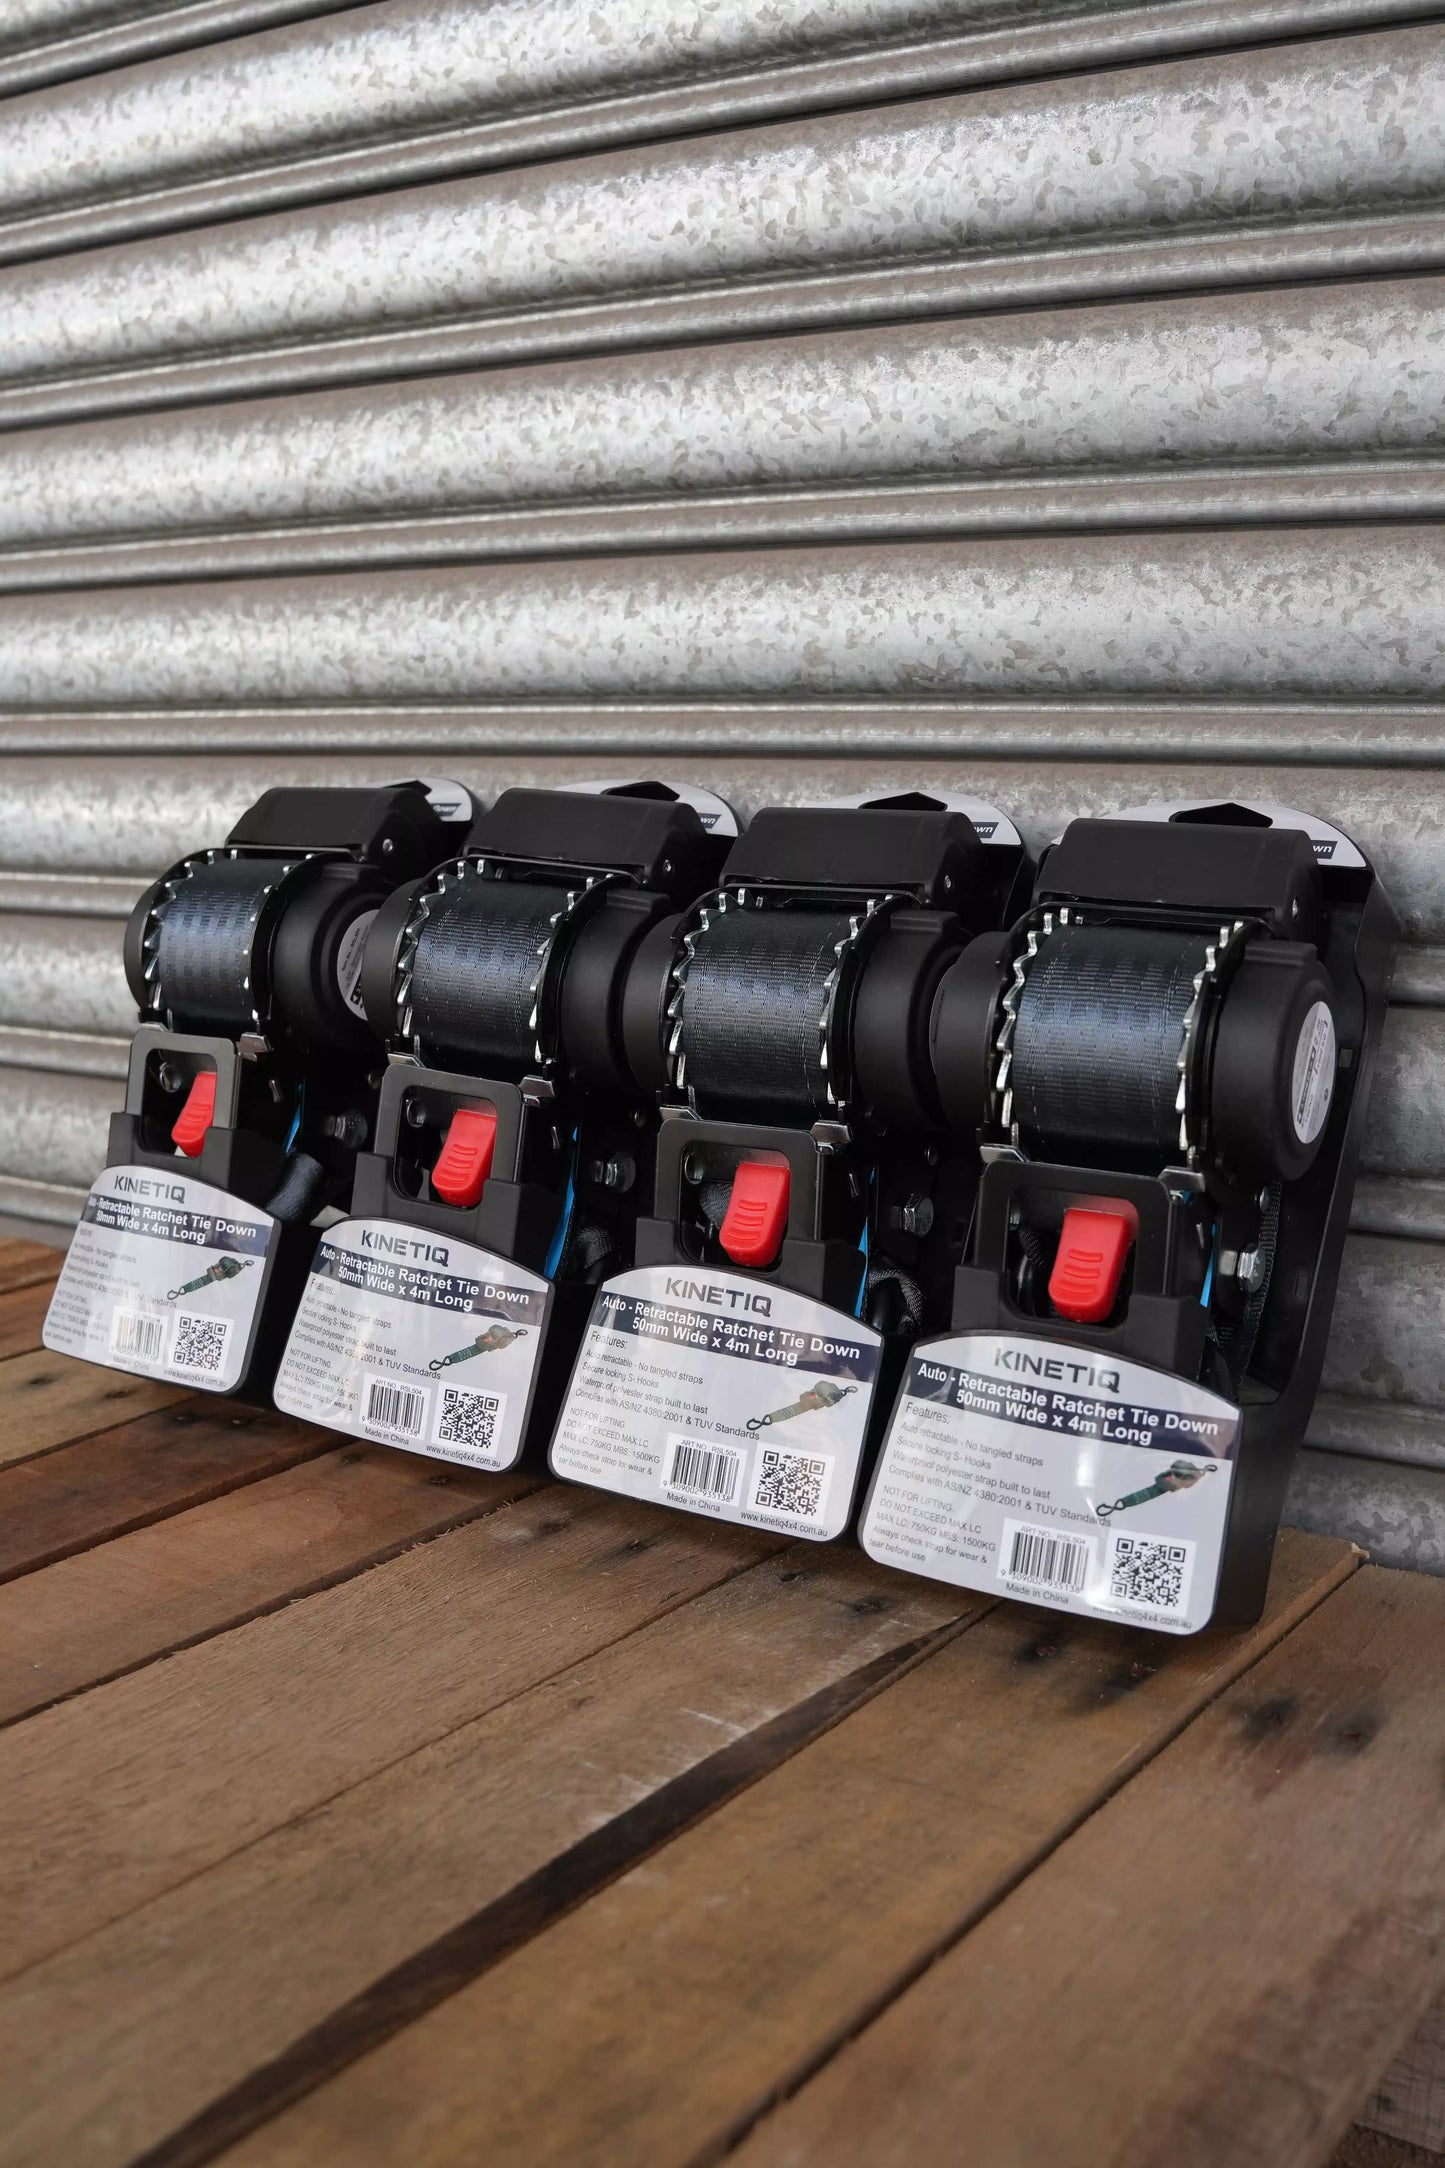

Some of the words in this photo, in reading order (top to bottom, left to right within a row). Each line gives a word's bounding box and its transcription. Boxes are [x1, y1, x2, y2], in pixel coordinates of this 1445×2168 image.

[114, 1175, 186, 1204] KINETIQ
[117, 1216, 140, 1230] Wide
[142, 1224, 149, 1232] x
[152, 1222, 169, 1236] 4m
[173, 1226, 206, 1245] Long
[142, 1207, 188, 1225] Ratchet
[191, 1215, 212, 1230] Tie
[216, 1221, 257, 1238] Down
[361, 1230, 449, 1267] KINETIQ
[321, 1245, 336, 1261] Auto
[340, 1253, 395, 1278] Retractable
[398, 1268, 452, 1290] Ratchet
[456, 1279, 479, 1295] Tie
[483, 1284, 530, 1305] Down
[338, 1266, 364, 1285] 50mm
[366, 1273, 395, 1292] Wide
[397, 1285, 406, 1295] x
[408, 1285, 430, 1300] 4m
[434, 1290, 473, 1311] Long
[665, 1277, 773, 1317] KINETIQ
[602, 1295, 627, 1311] Auto
[635, 1302, 709, 1329] Retractable
[712, 1318, 776, 1343] Ratchet
[780, 1331, 806, 1349] Tie
[810, 1337, 860, 1359] Down
[632, 1316, 670, 1336] 50mm
[672, 1325, 709, 1345] Wide
[711, 1337, 722, 1348] x
[724, 1336, 751, 1353] 4m
[755, 1343, 800, 1366] Long
[386, 1359, 401, 1370] TUV
[403, 1364, 441, 1380] Standards
[994, 1348, 1120, 1393] KINETIQ
[917, 1363, 947, 1382] Auto
[958, 1373, 1047, 1407] Retractable
[1052, 1395, 1125, 1421] Ratchet
[1130, 1408, 1159, 1427] Tie
[1164, 1414, 1218, 1435] Down
[695, 1418, 714, 1430] TUV
[715, 1423, 760, 1440] Standards
[956, 1389, 1000, 1413] 50mm
[1005, 1401, 1047, 1424] Wide
[1052, 1415, 1063, 1427] x
[1067, 1415, 1097, 1433] 4m
[1103, 1421, 1152, 1446] Long
[365, 1427, 382, 1438] Made
[390, 1433, 409, 1445] China
[666, 1491, 688, 1503] Made
[698, 1498, 721, 1511] China
[1036, 1504, 1057, 1516] TUV
[741, 1513, 829, 1537] www.kinetiq4x4.com.au
[1005, 1581, 1030, 1595] Made
[1043, 1590, 1068, 1604] China
